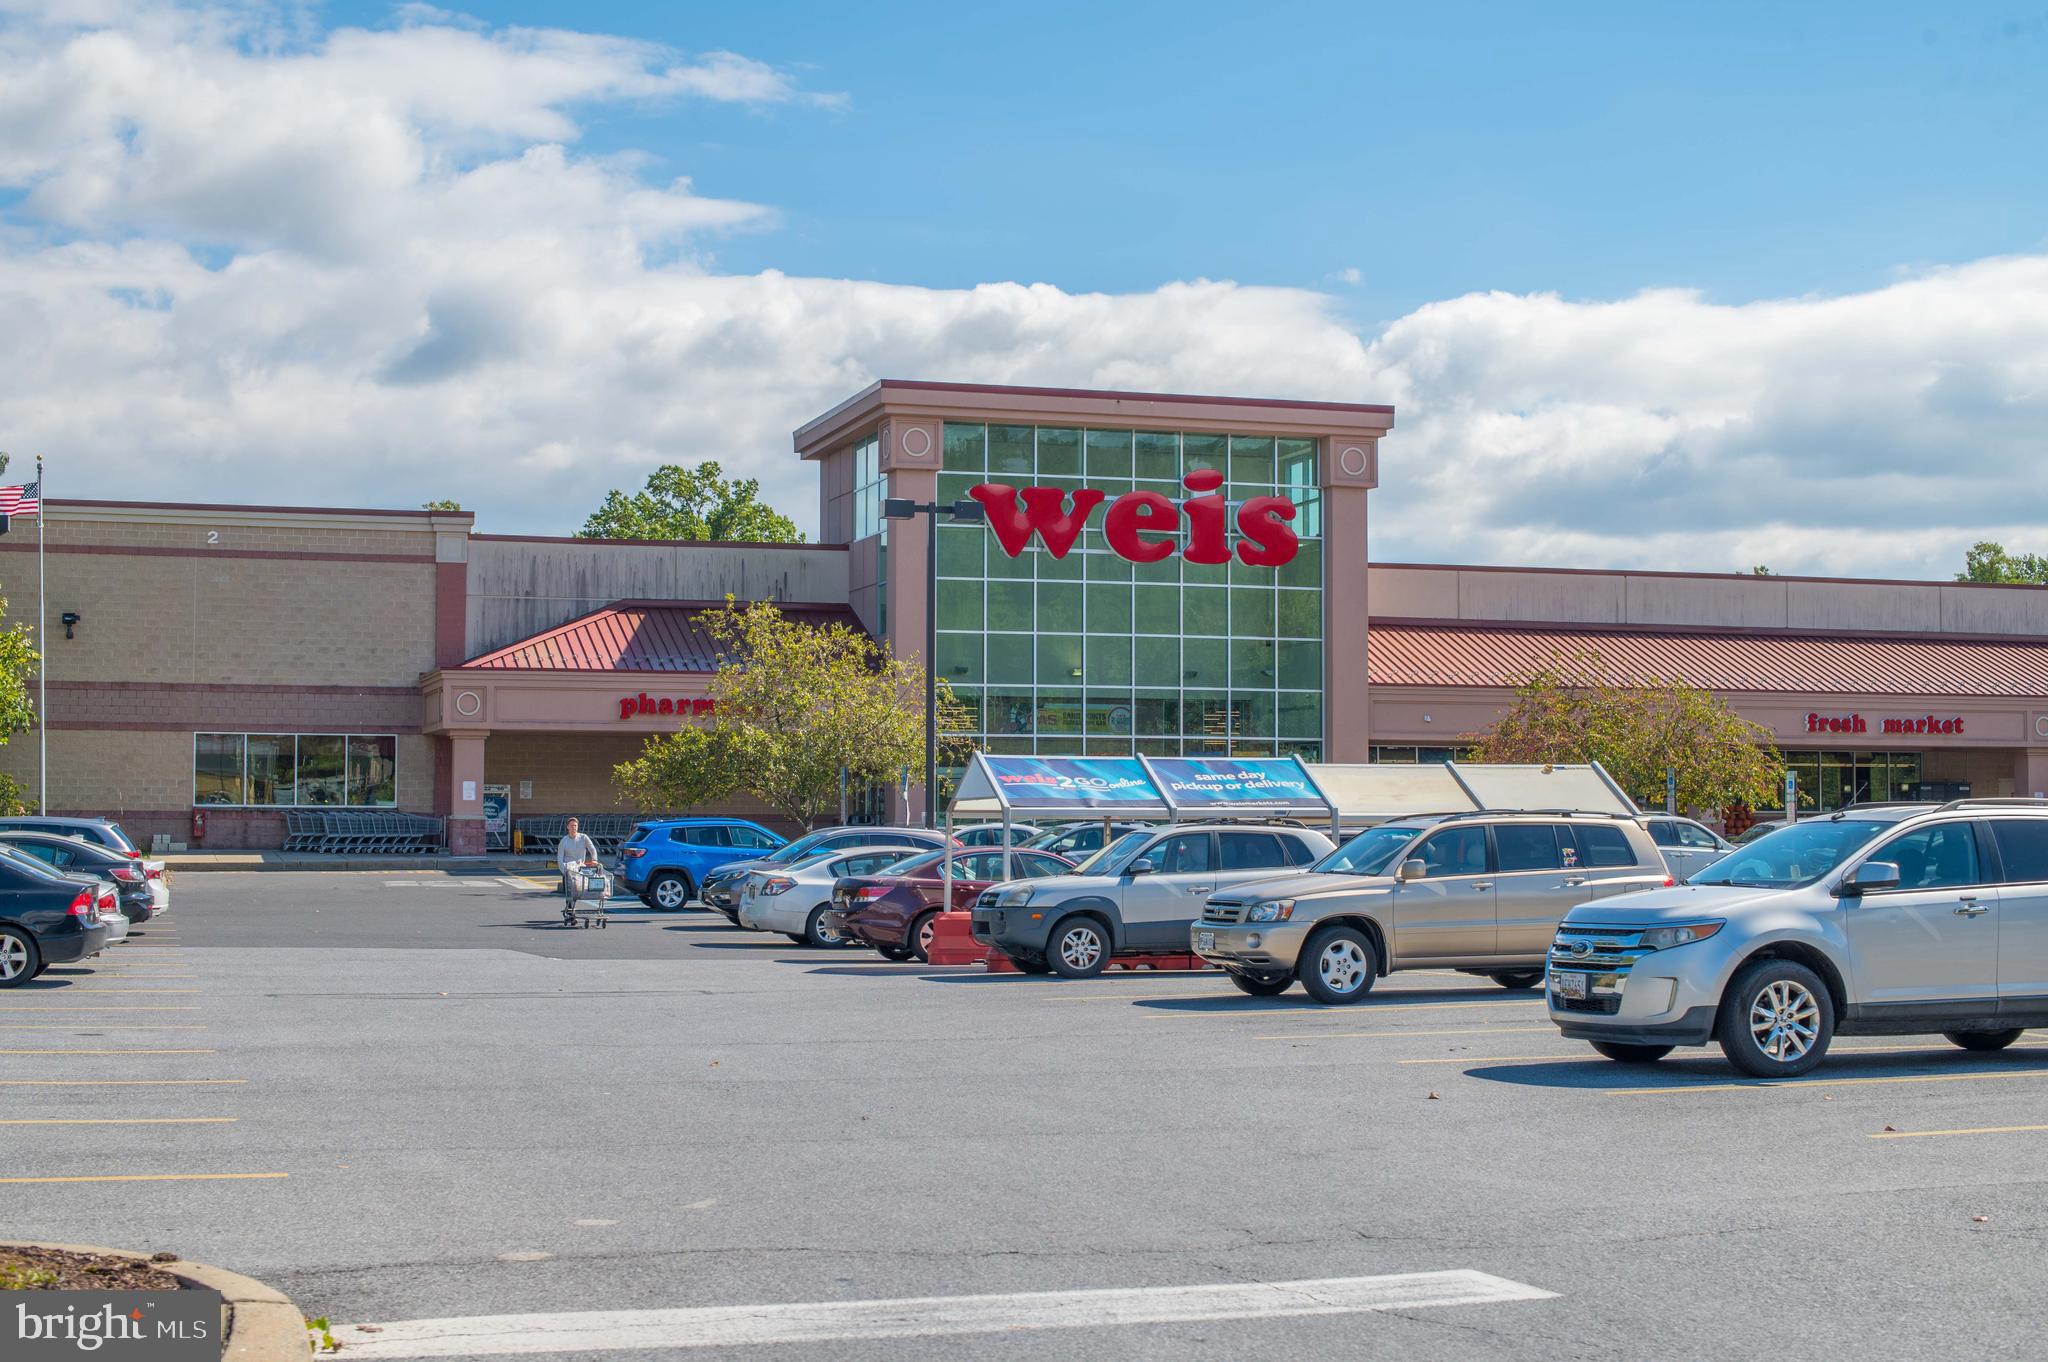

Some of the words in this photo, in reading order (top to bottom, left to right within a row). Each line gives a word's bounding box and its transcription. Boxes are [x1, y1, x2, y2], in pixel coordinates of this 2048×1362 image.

[966, 468, 1299, 567] weis
[207, 531, 219, 544] 2
[1805, 712, 1867, 733] fresh
[1880, 715, 1965, 735] market
[1194, 773, 1236, 781] same
[1239, 771, 1265, 782] day
[1170, 781, 1224, 792] pickup
[1225, 782, 1242, 790] or
[1244, 779, 1305, 790] delivery
